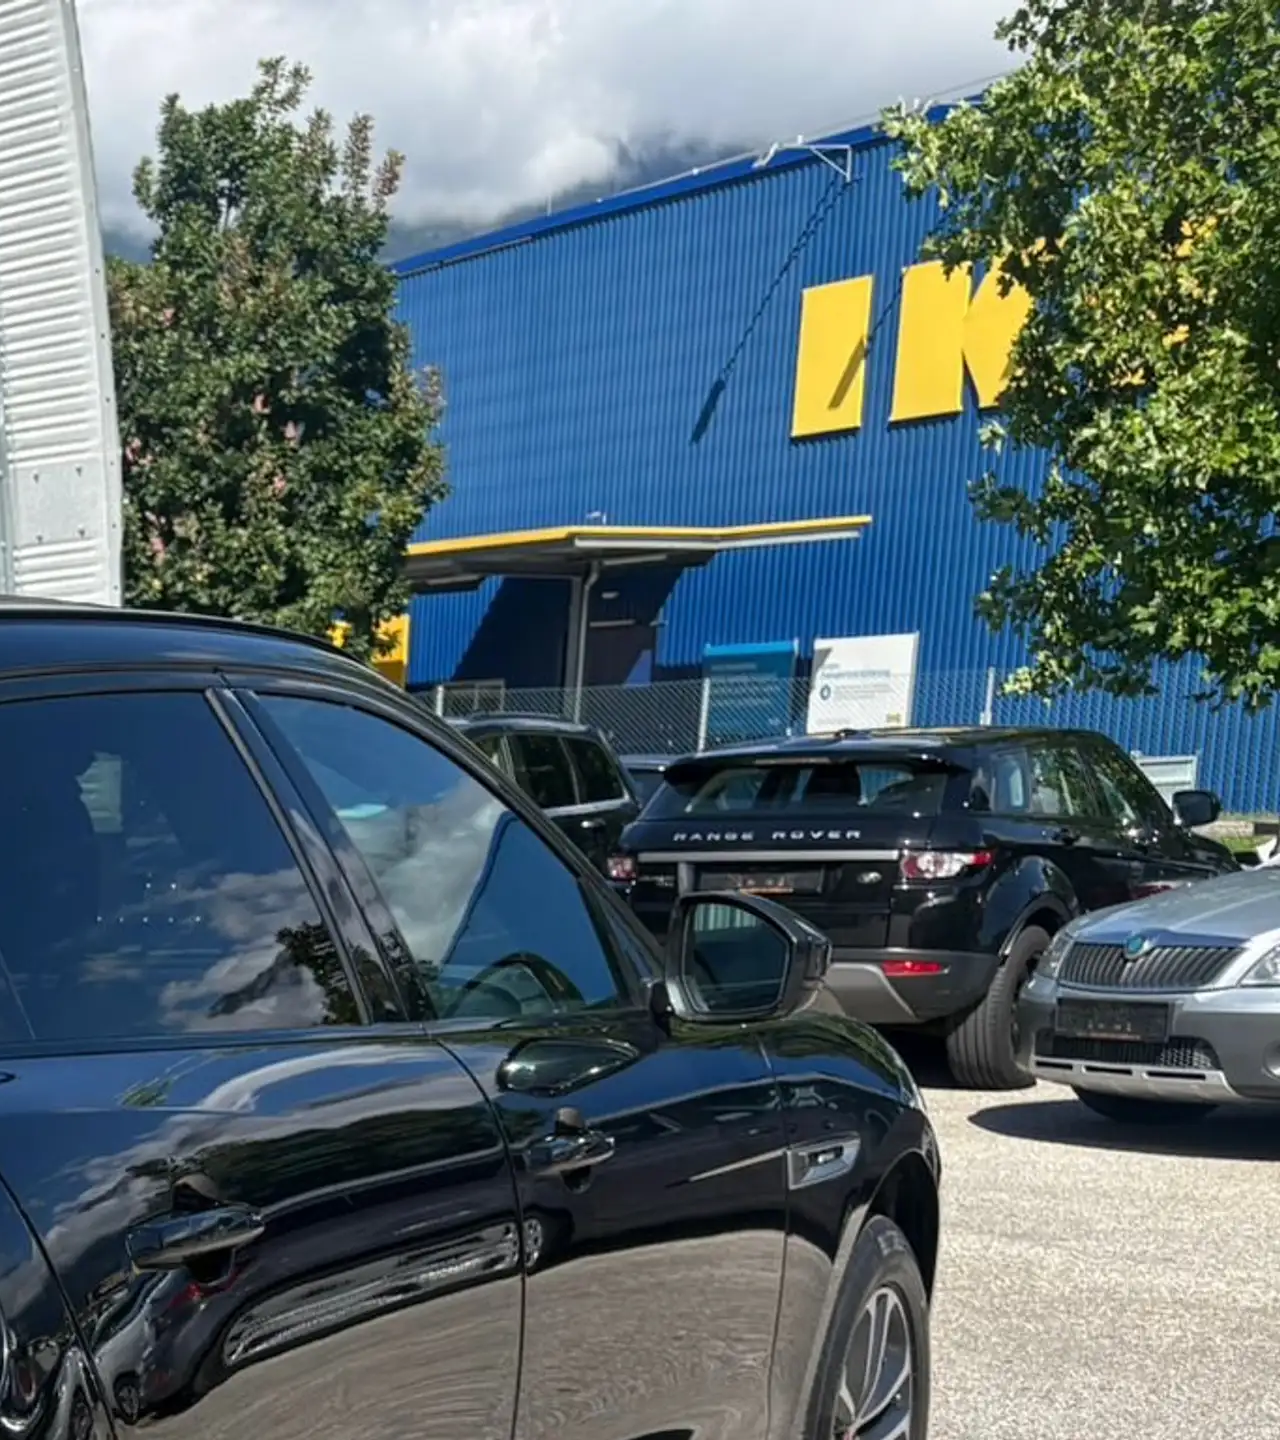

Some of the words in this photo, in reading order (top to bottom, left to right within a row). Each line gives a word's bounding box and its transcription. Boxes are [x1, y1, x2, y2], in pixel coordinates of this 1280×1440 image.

[790, 256, 1036, 439] IK
[673, 831, 755, 842] RANGE
[772, 829, 861, 841] ROVER
